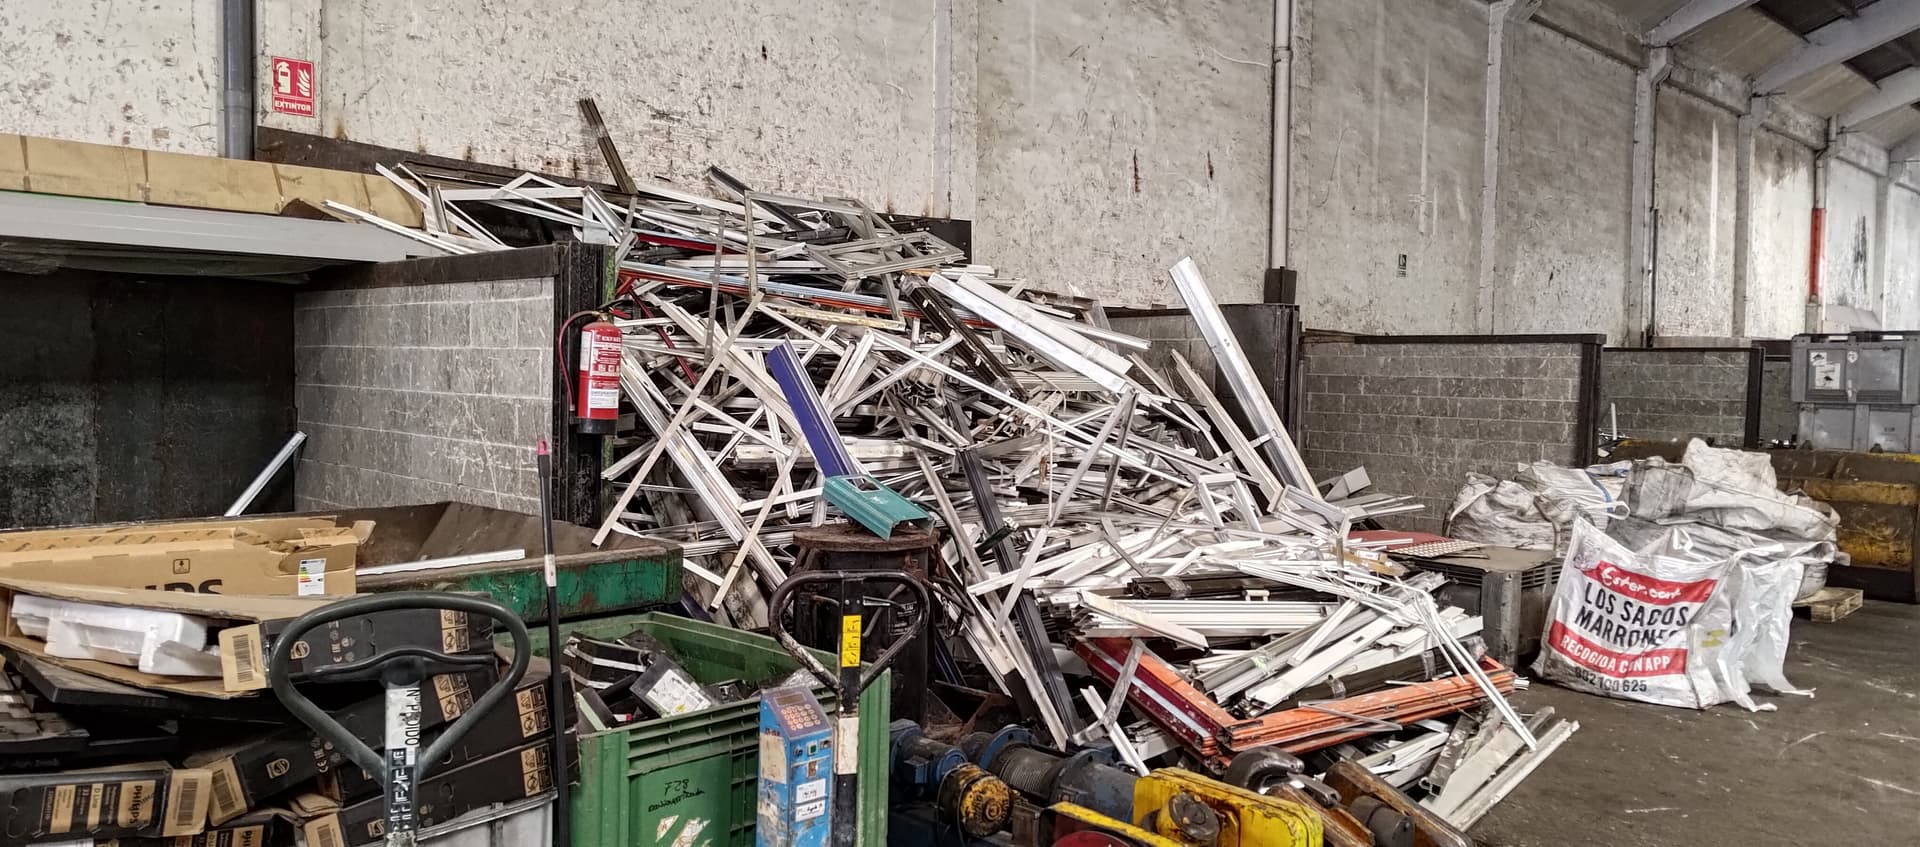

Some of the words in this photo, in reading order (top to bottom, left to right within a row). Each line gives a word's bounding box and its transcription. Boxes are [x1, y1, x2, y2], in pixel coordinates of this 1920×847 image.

[274, 100, 311, 111] EXTINTOR
[1584, 582, 1617, 615] LOS
[1620, 600, 1689, 627] SACOS
[1560, 635, 1617, 672] RECOGIDA
[1619, 656, 1643, 674] CN
[1645, 655, 1671, 672] APP
[1622, 679, 1648, 692] 625
